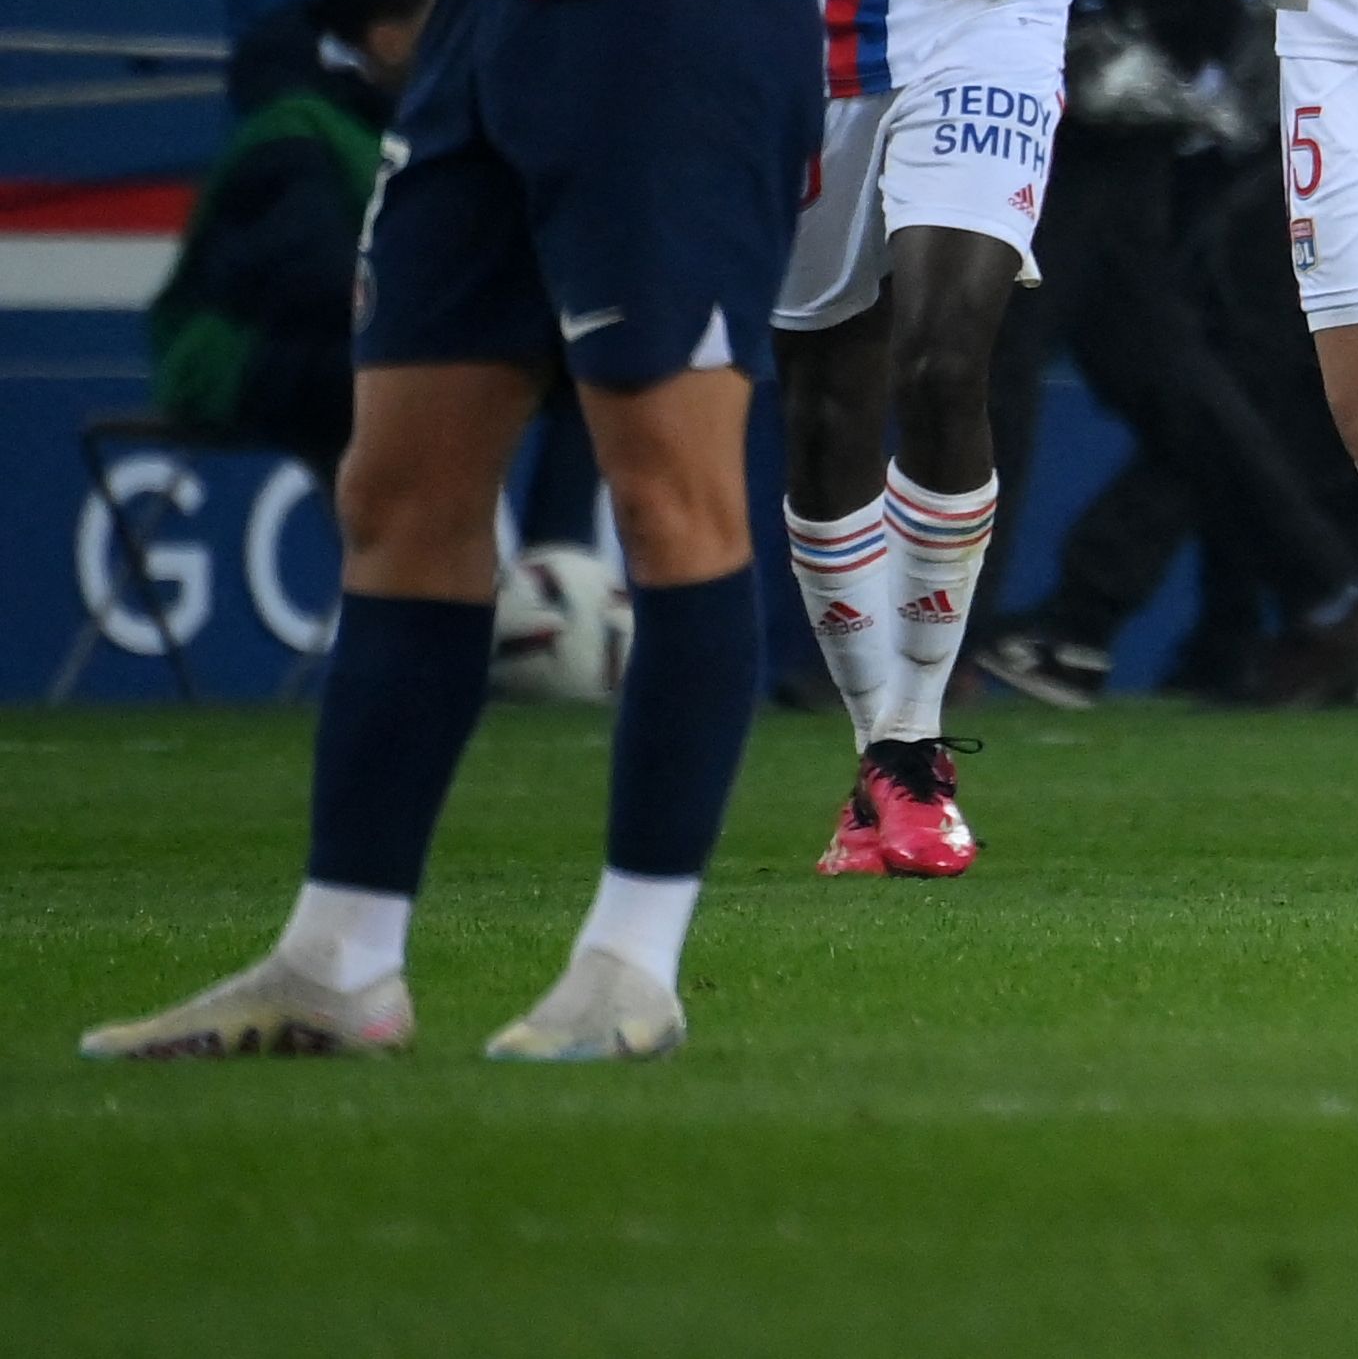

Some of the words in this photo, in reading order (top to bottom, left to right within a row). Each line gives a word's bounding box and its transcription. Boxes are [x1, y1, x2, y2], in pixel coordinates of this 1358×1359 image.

[934, 86, 1051, 136] TEDDY
[933, 123, 1045, 178] SMITH
[1291, 106, 1322, 199] 5
